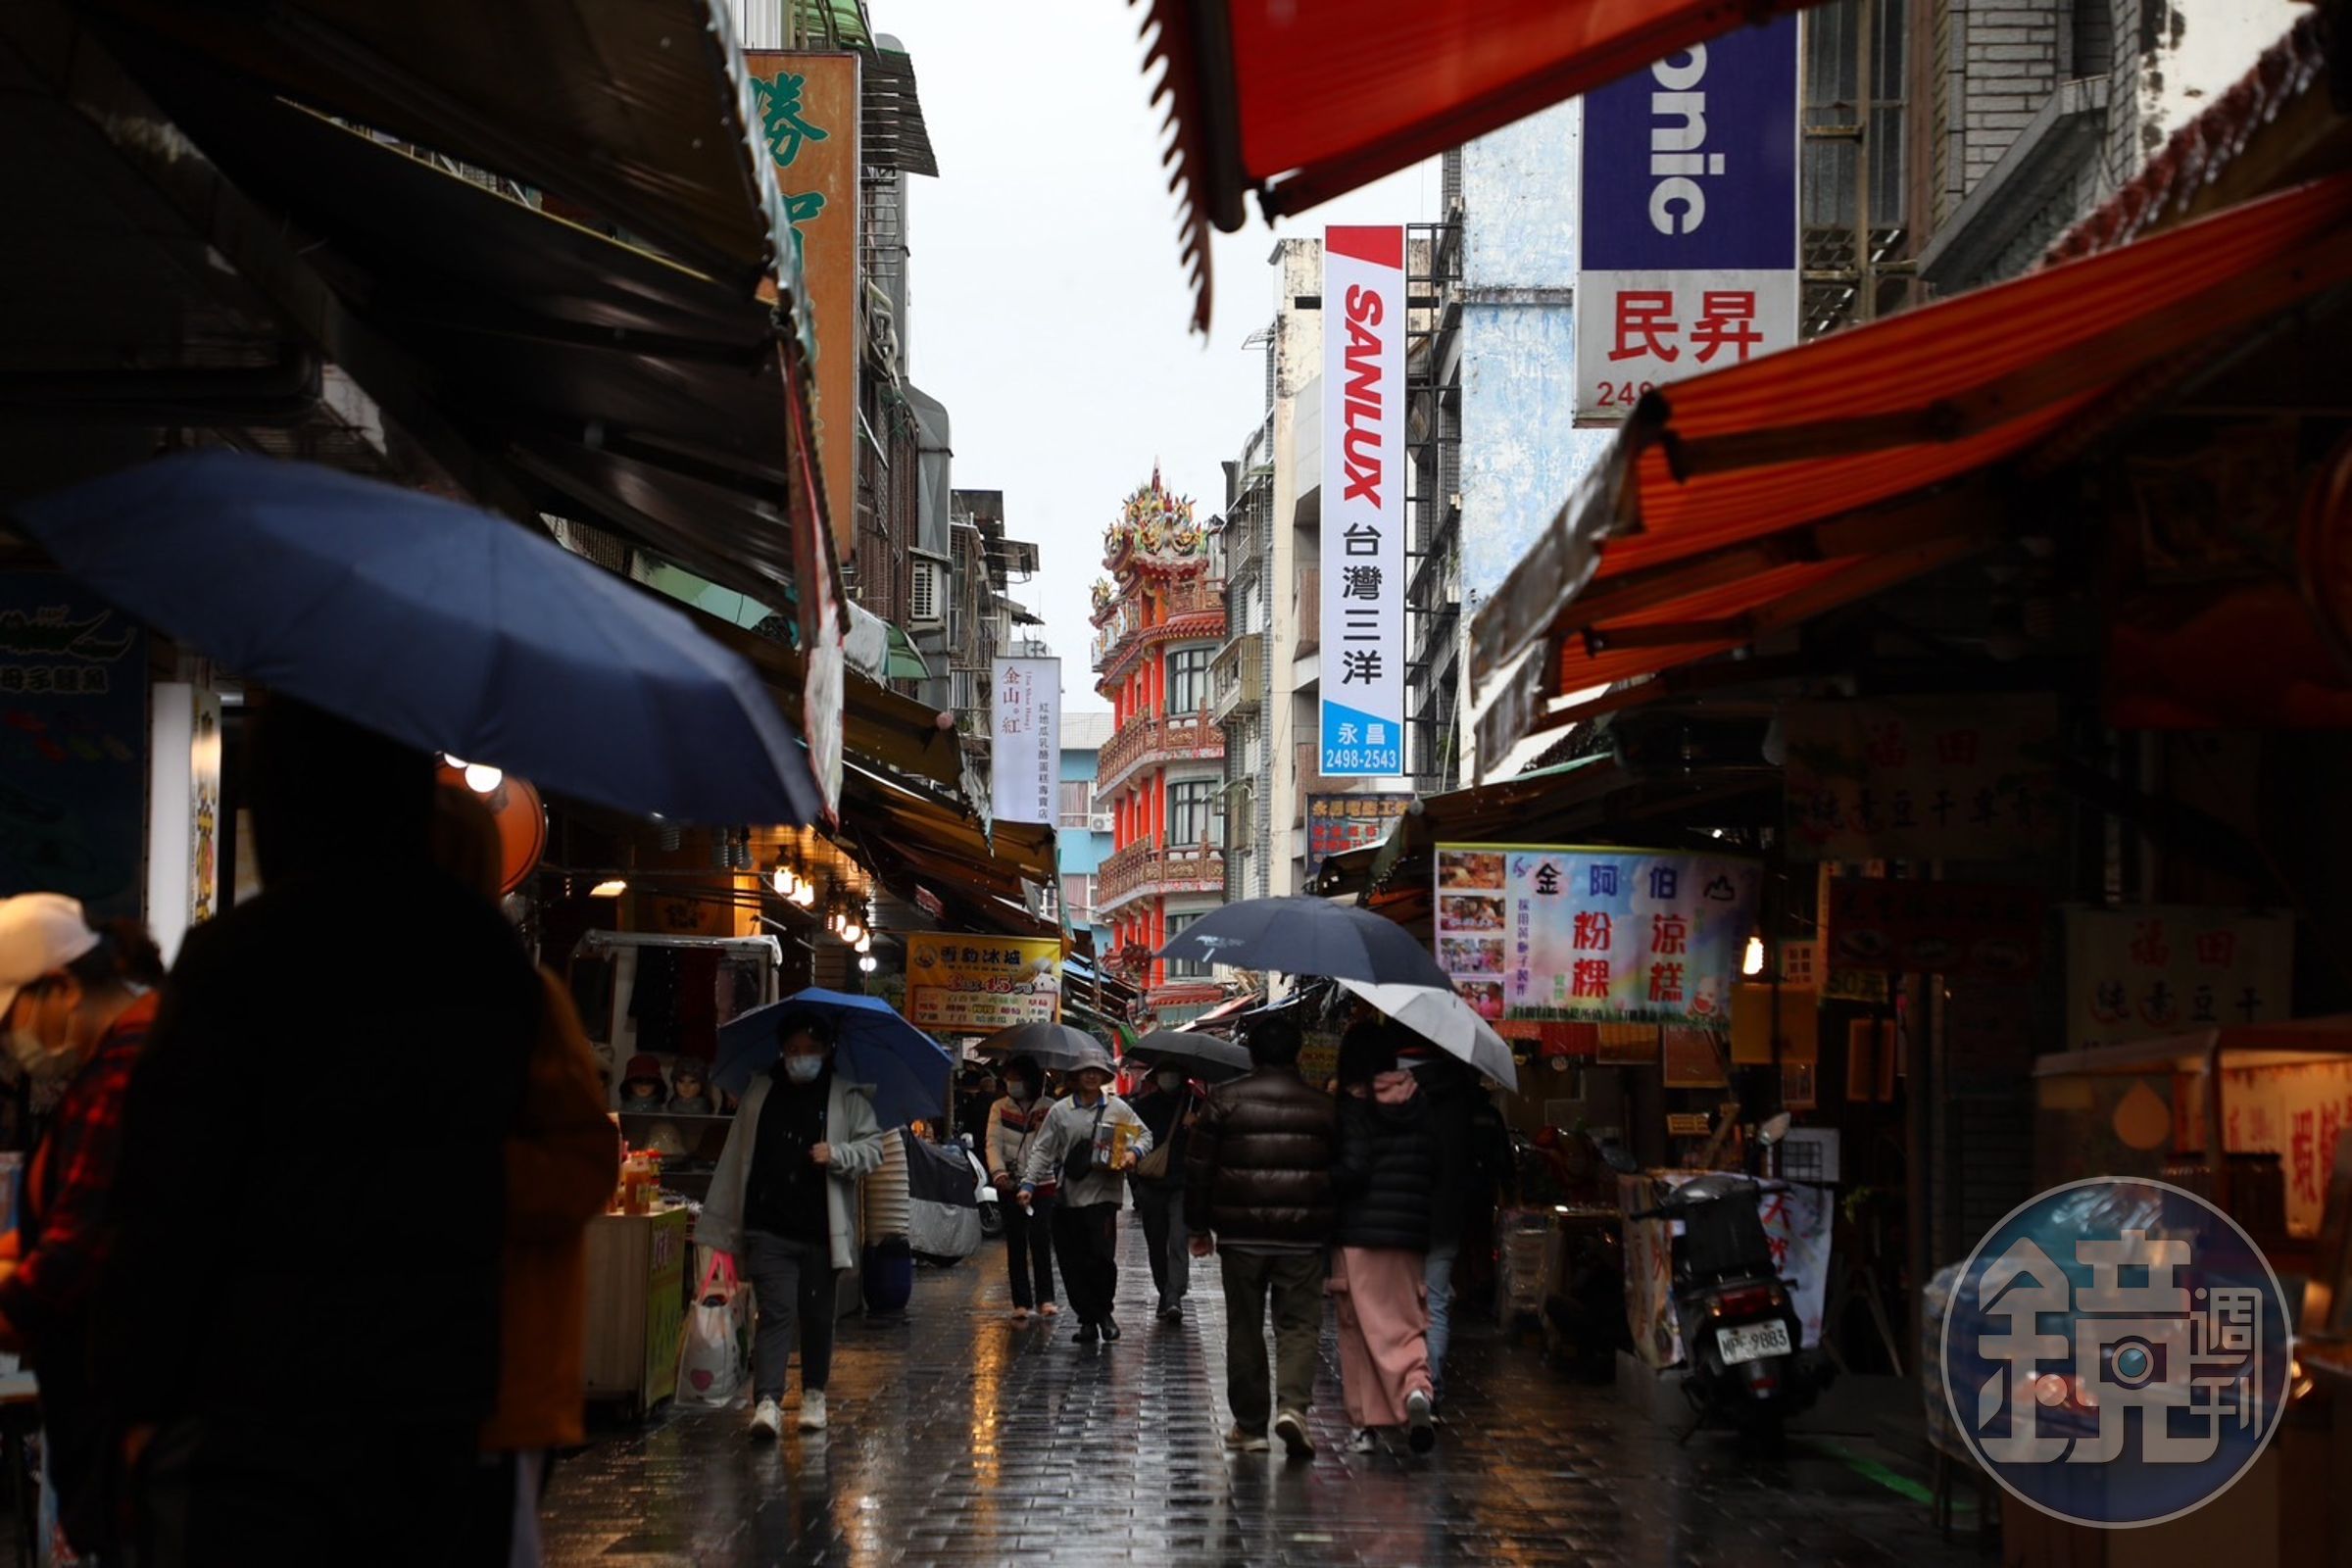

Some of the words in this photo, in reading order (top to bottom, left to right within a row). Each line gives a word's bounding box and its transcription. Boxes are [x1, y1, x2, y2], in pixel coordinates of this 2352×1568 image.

[1608, 291, 1763, 364] 民昇
[1344, 283, 1384, 510] SANLUX
[1342, 522, 1383, 685] 台灣三洋
[1326, 749, 1396, 768] 2498-2543
[1338, 722, 1387, 746] 永昌
[1536, 862, 1678, 899] 金阿伯
[1572, 910, 1612, 999] 粉粿
[1647, 913, 1688, 1003] 涼糕
